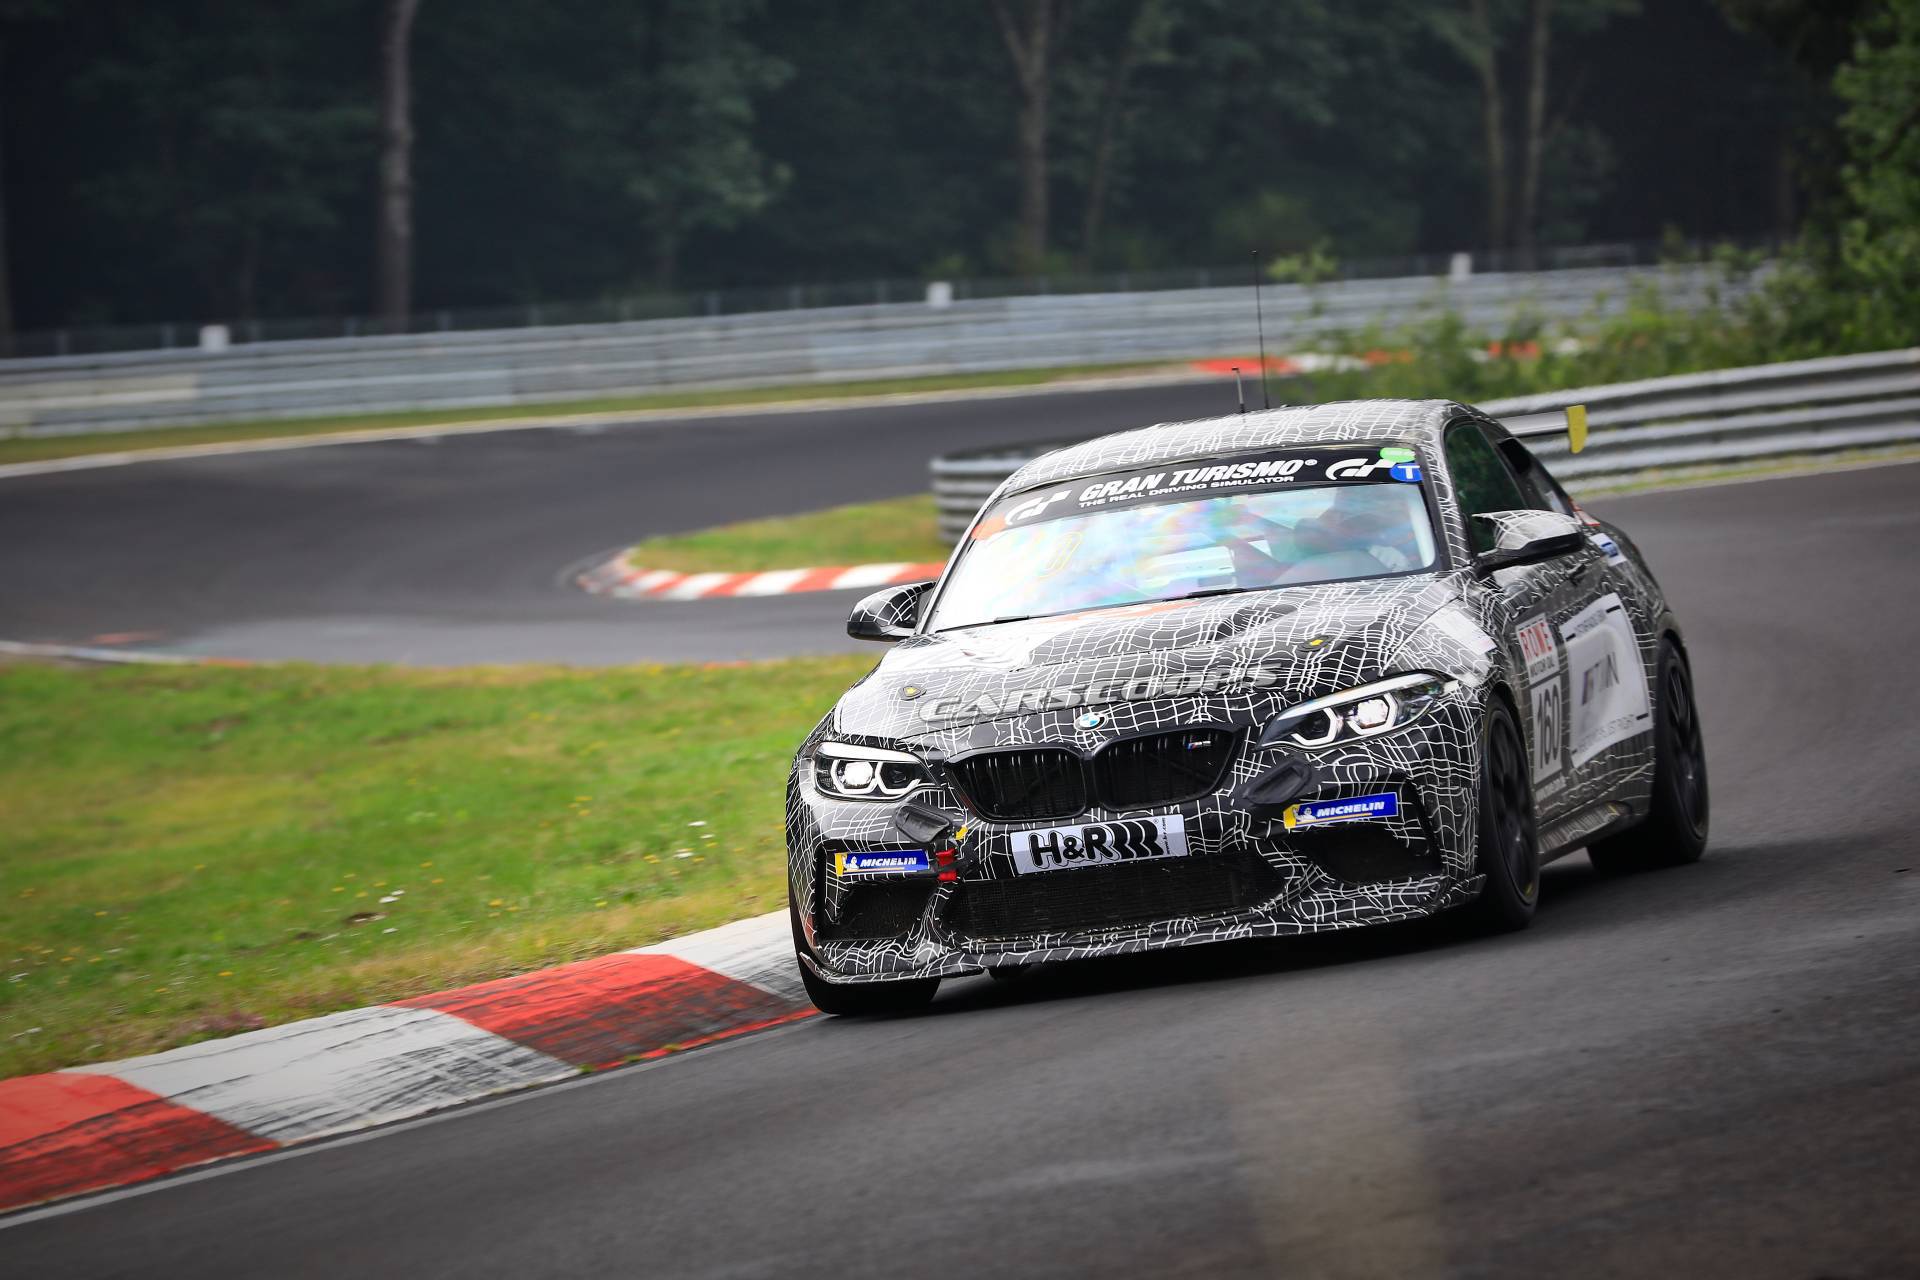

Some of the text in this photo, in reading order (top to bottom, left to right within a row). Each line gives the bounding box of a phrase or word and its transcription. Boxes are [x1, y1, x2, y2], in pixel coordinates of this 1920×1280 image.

[1078, 472, 1166, 501] GRAN
[1397, 464, 1421, 480] T
[1079, 476, 1294, 508] THE REAL DRIVING SIMULATOR
[1537, 684, 1560, 769] 160
[1316, 801, 1385, 818] MICHELIN
[1029, 825, 1122, 869] H&R
[860, 857, 917, 867] MICHELIN
